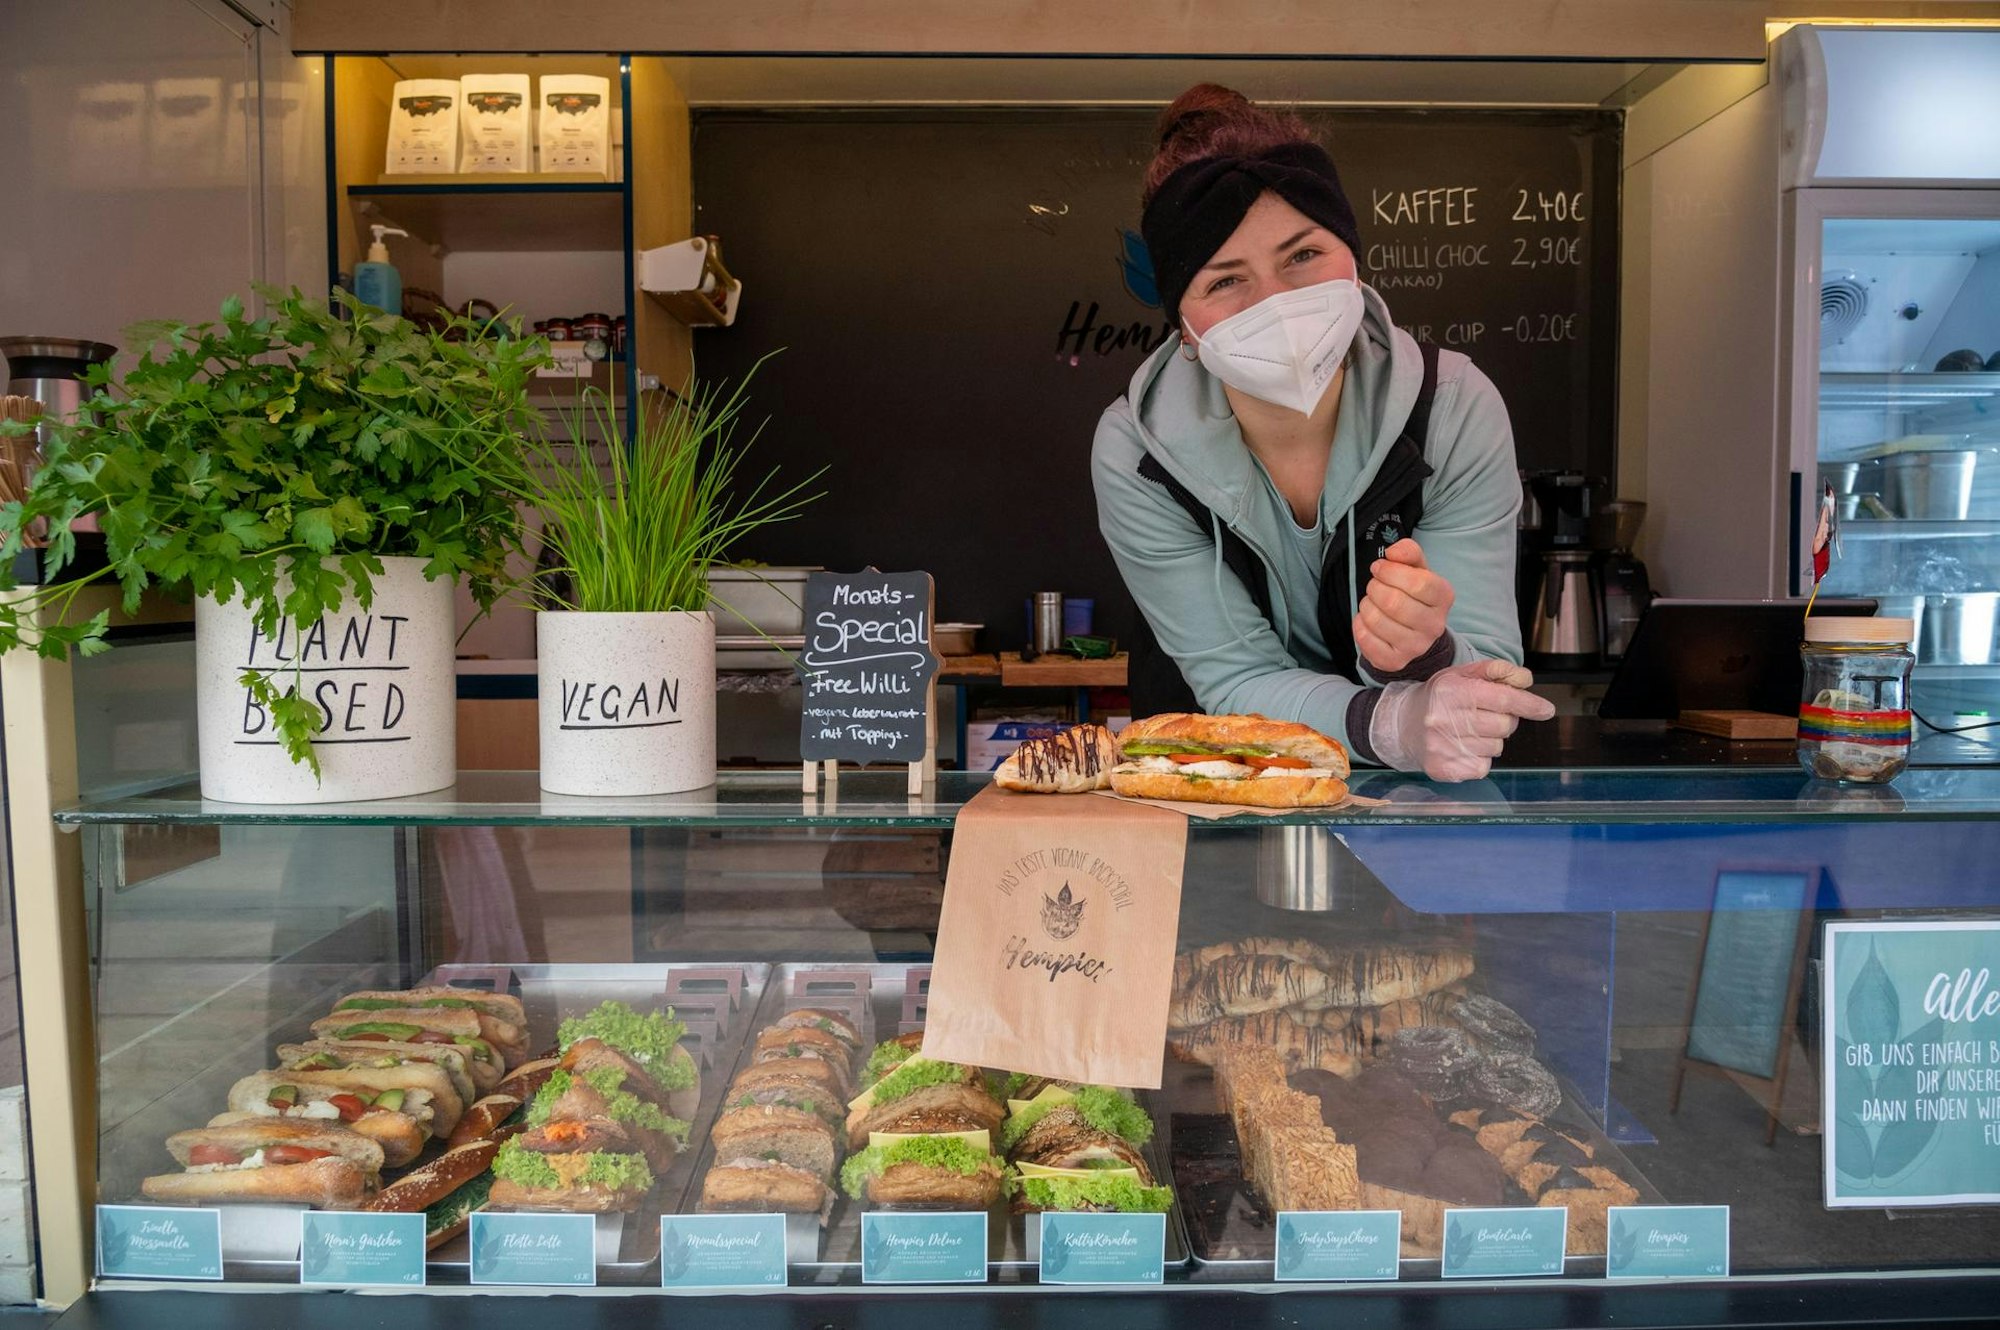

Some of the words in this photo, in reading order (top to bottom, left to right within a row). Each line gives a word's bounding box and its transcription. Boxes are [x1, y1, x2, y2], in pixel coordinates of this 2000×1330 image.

[1373, 187, 1478, 226] KAFFEE
[1435, 243, 1490, 267] CHOC
[1446, 322, 1485, 345] CUP
[814, 611, 928, 653] Special
[244, 680, 404, 734] BSED
[563, 678, 679, 722] VEGAN
[998, 870, 1020, 896] DAS
[1015, 850, 1047, 878] ERSTE
[1051, 848, 1089, 871] VEGANE
[1846, 1043, 1873, 1066] GIB
[1882, 1043, 1914, 1066] UNS
[1922, 1040, 1981, 1065] EINFACH
[1917, 1069, 1939, 1094] DIR
[1863, 1098, 1906, 1121] DANN
[1915, 1096, 1967, 1121] FINDEN
